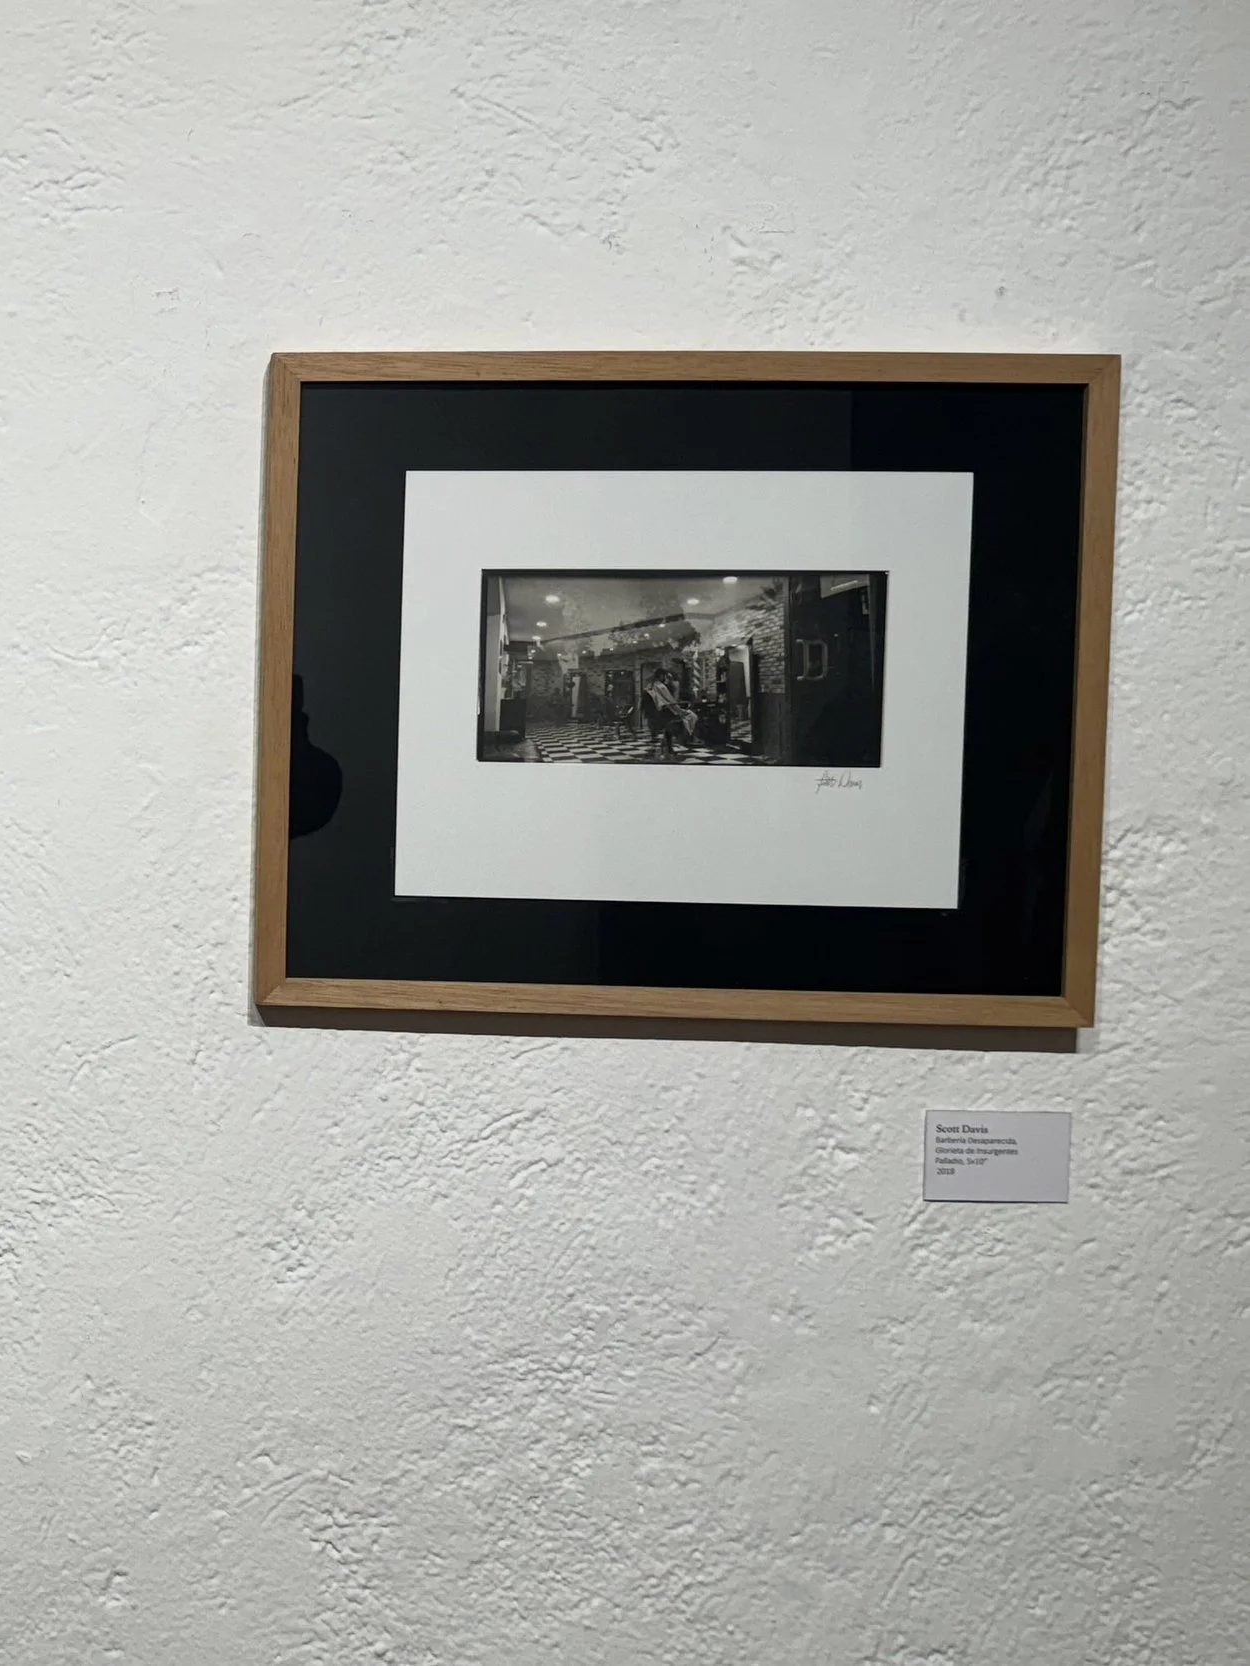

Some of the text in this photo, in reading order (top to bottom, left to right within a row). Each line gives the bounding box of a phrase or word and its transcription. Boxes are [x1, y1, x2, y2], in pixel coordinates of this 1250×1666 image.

[935, 1124, 989, 1134] Scott Davis
[976, 1148, 1018, 1156] Insurgentes
